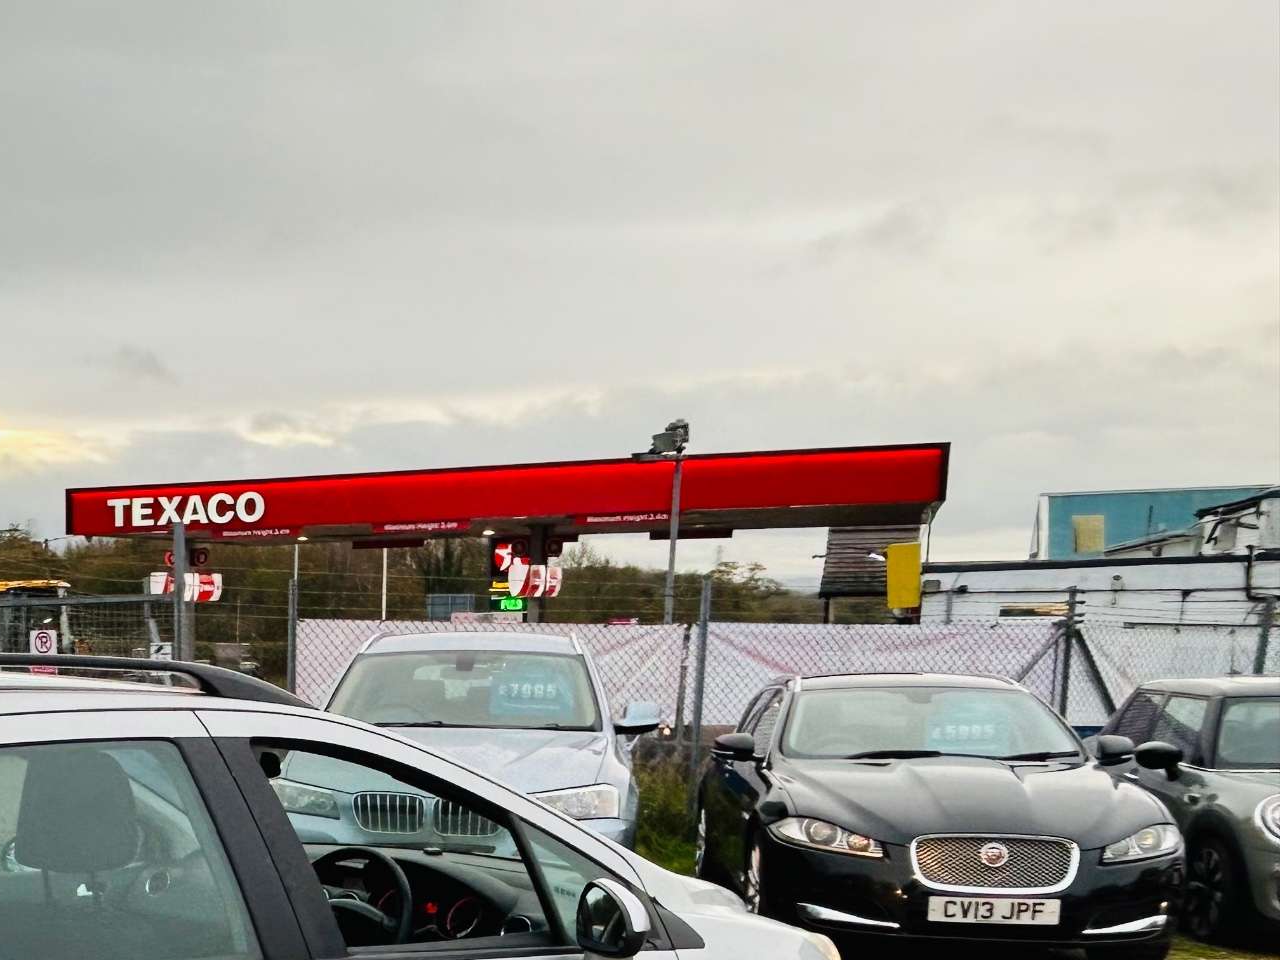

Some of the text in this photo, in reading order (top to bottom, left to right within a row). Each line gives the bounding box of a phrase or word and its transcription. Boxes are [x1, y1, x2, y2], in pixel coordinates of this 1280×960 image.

[106, 491, 265, 528] TEXACO
[943, 900, 1046, 921] CV13 JPF
